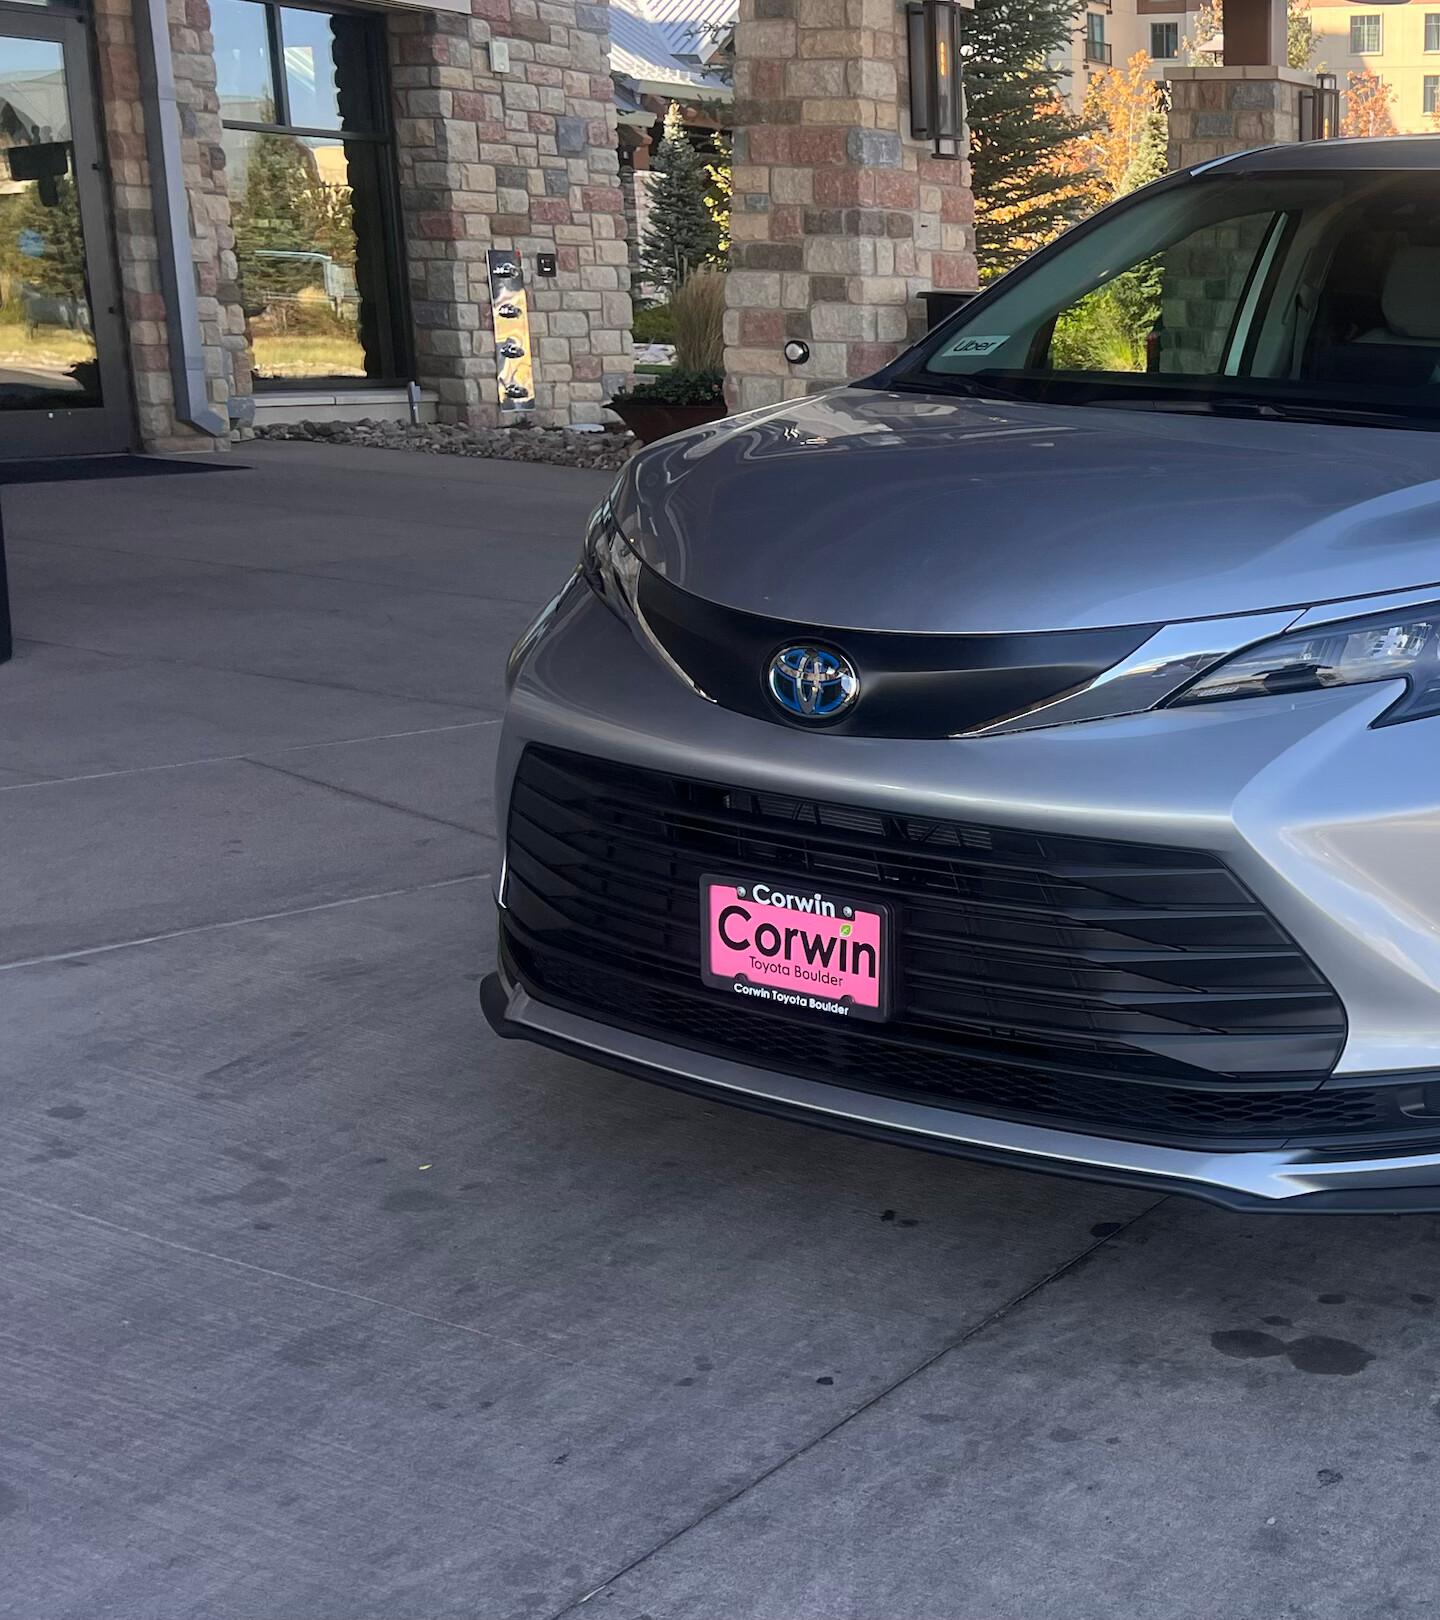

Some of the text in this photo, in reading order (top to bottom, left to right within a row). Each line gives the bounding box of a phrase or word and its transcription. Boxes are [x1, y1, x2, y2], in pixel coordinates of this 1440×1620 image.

[953, 340, 997, 352] Uber
[752, 884, 836, 918] Corwin
[718, 905, 876, 979] Corwin
[749, 956, 843, 986] Toyota Boulder
[733, 983, 849, 1015] Corwin Toyota Boulder
